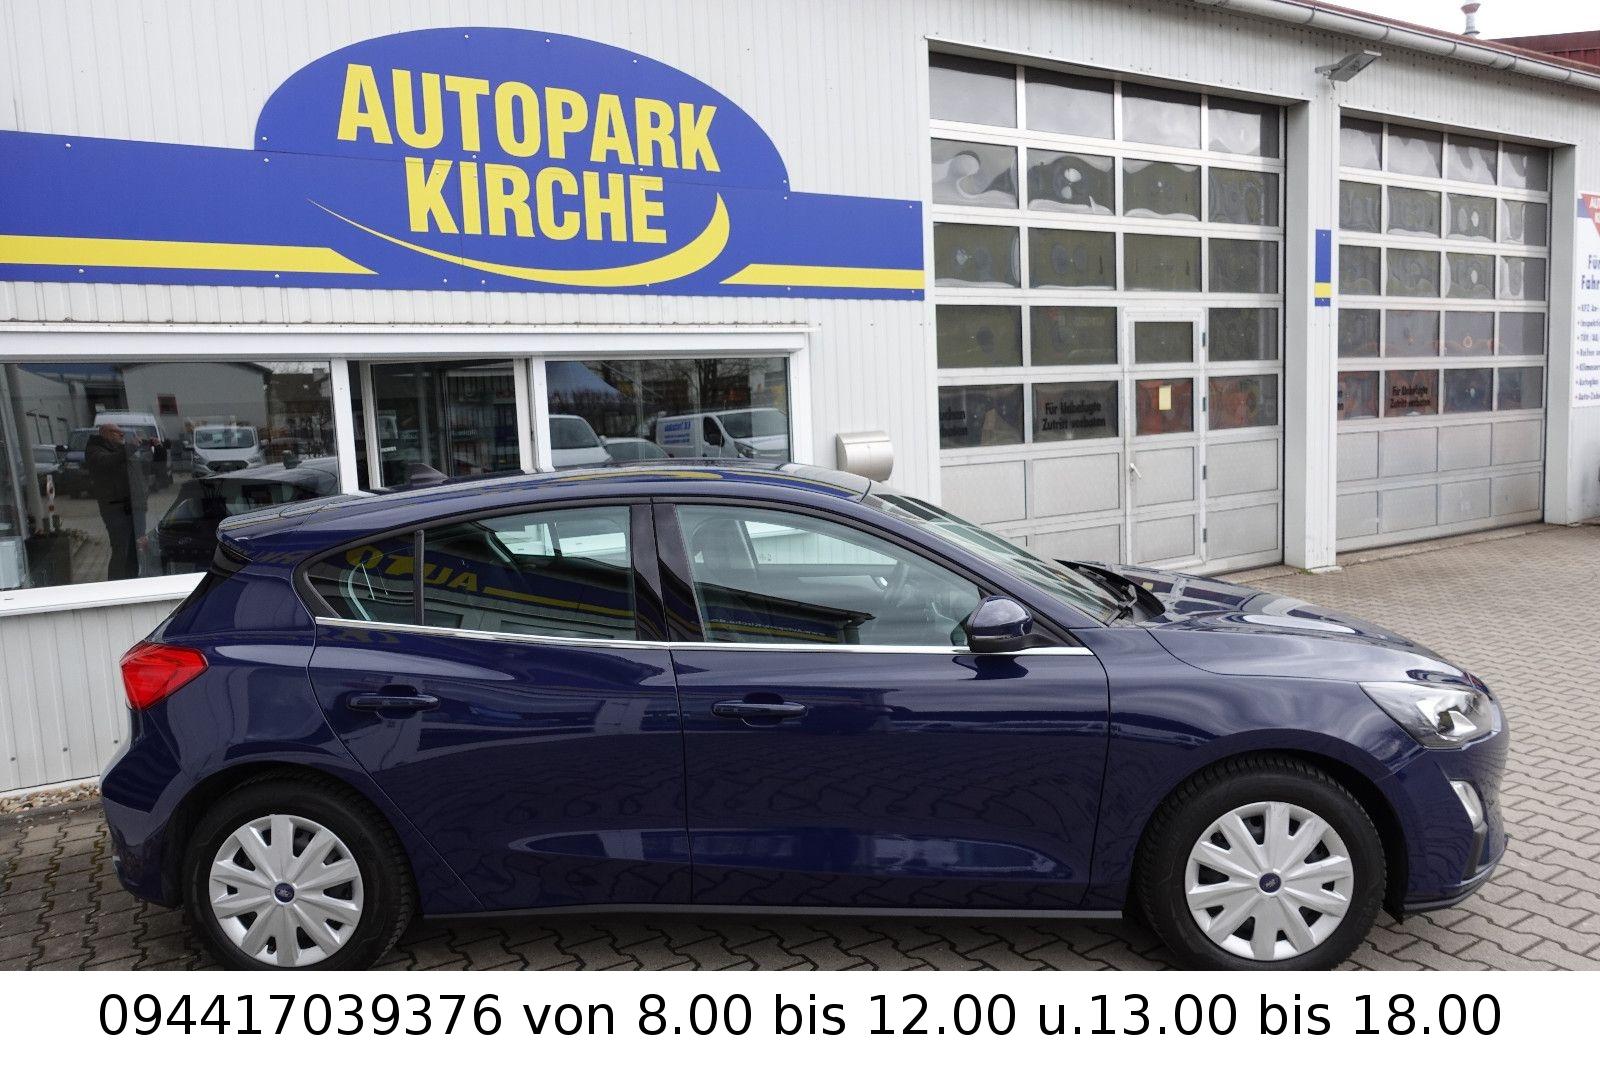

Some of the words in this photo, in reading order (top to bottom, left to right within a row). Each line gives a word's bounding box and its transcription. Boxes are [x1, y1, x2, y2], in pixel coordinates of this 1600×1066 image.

[338, 63, 720, 172] AUTOPARK
[405, 157, 667, 244] KIRCHE
[1042, 417, 1068, 431] Zutritt
[1045, 402, 1058, 415] Für
